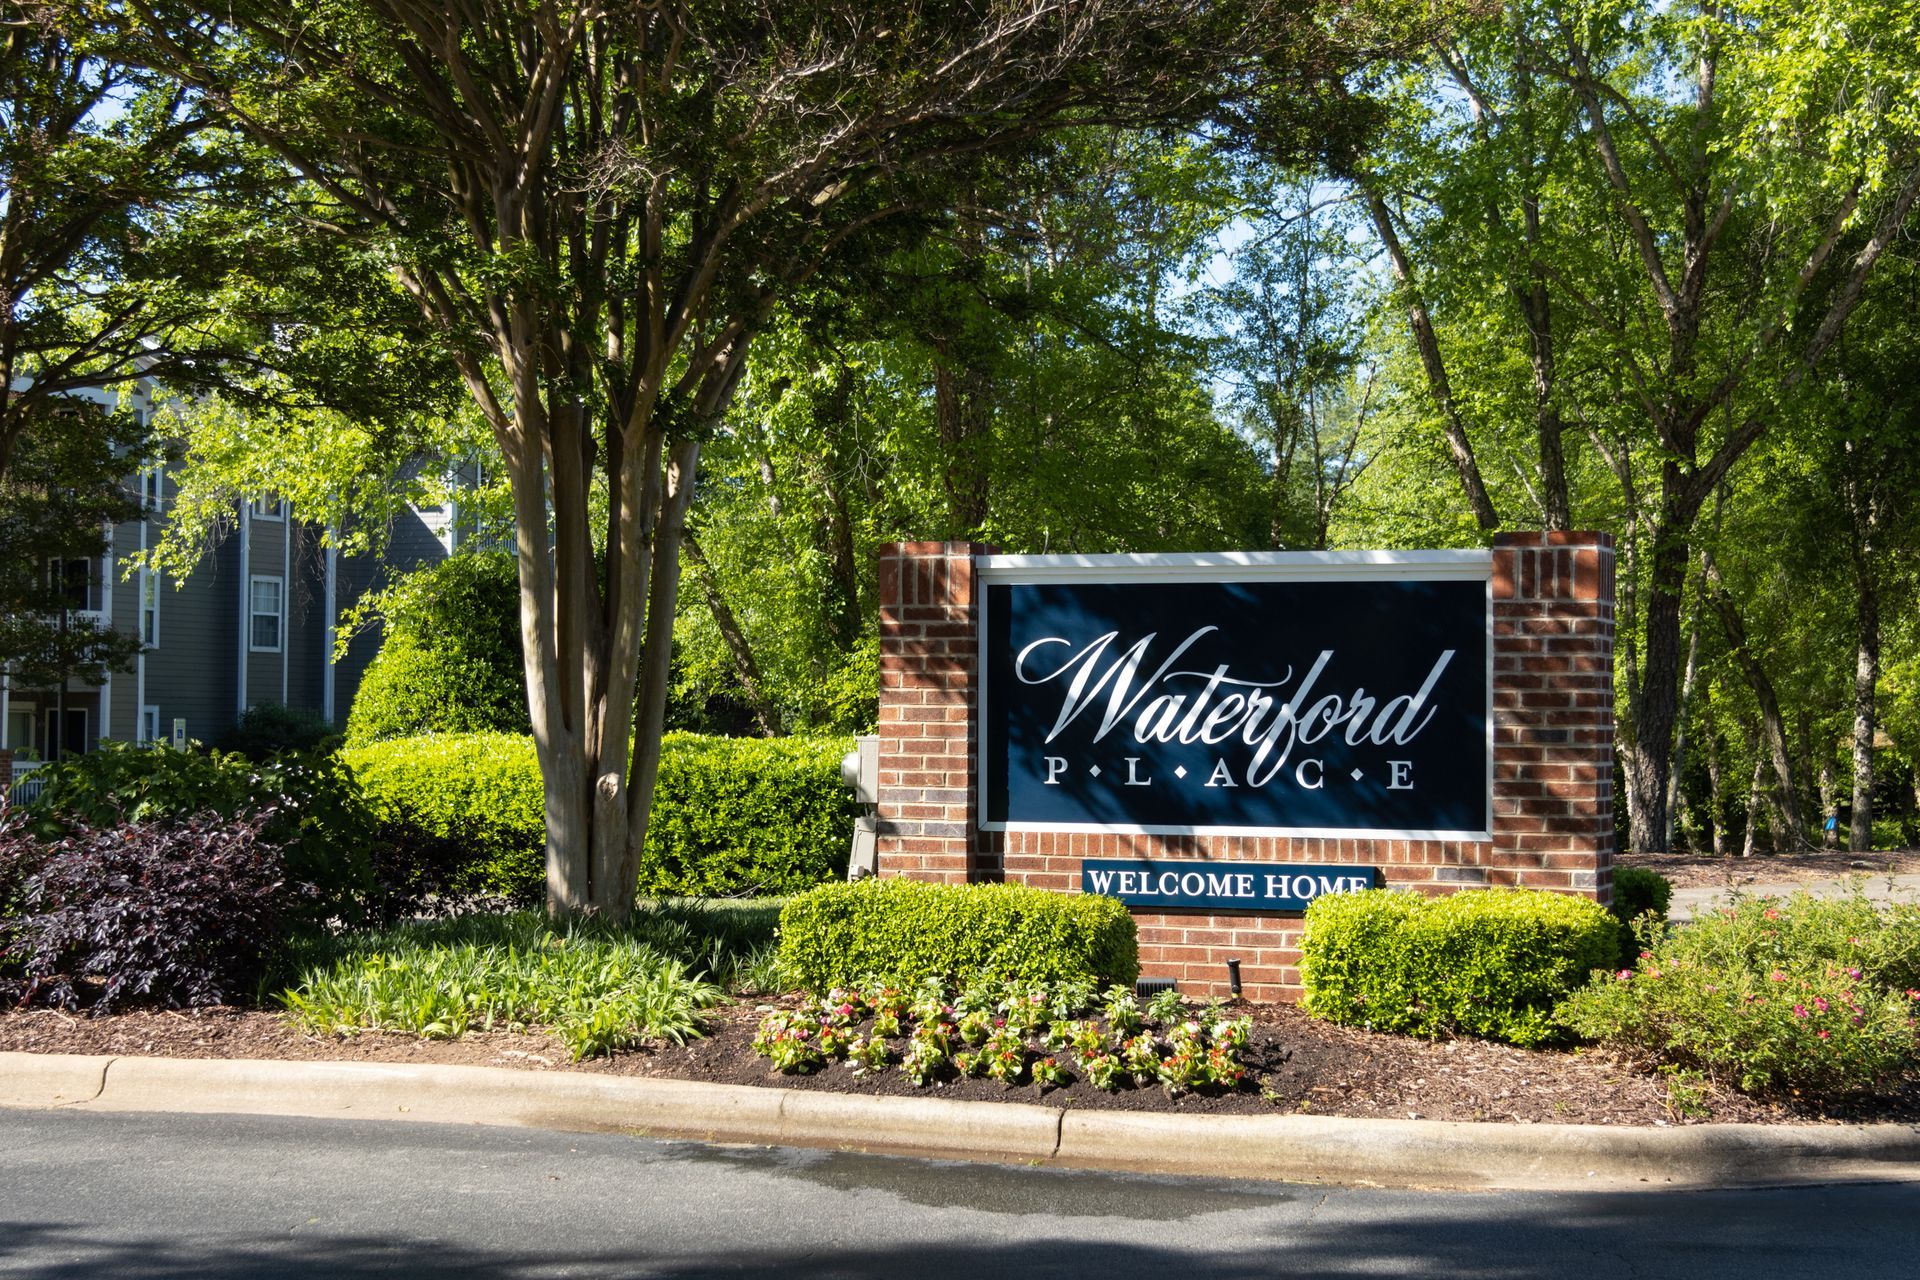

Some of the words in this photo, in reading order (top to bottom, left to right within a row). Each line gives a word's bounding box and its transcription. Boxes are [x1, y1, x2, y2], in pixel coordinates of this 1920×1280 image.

[1015, 625, 1456, 788] Waterford
[1087, 870, 1255, 898] WELCOME
[1264, 875, 1367, 899] HOME
